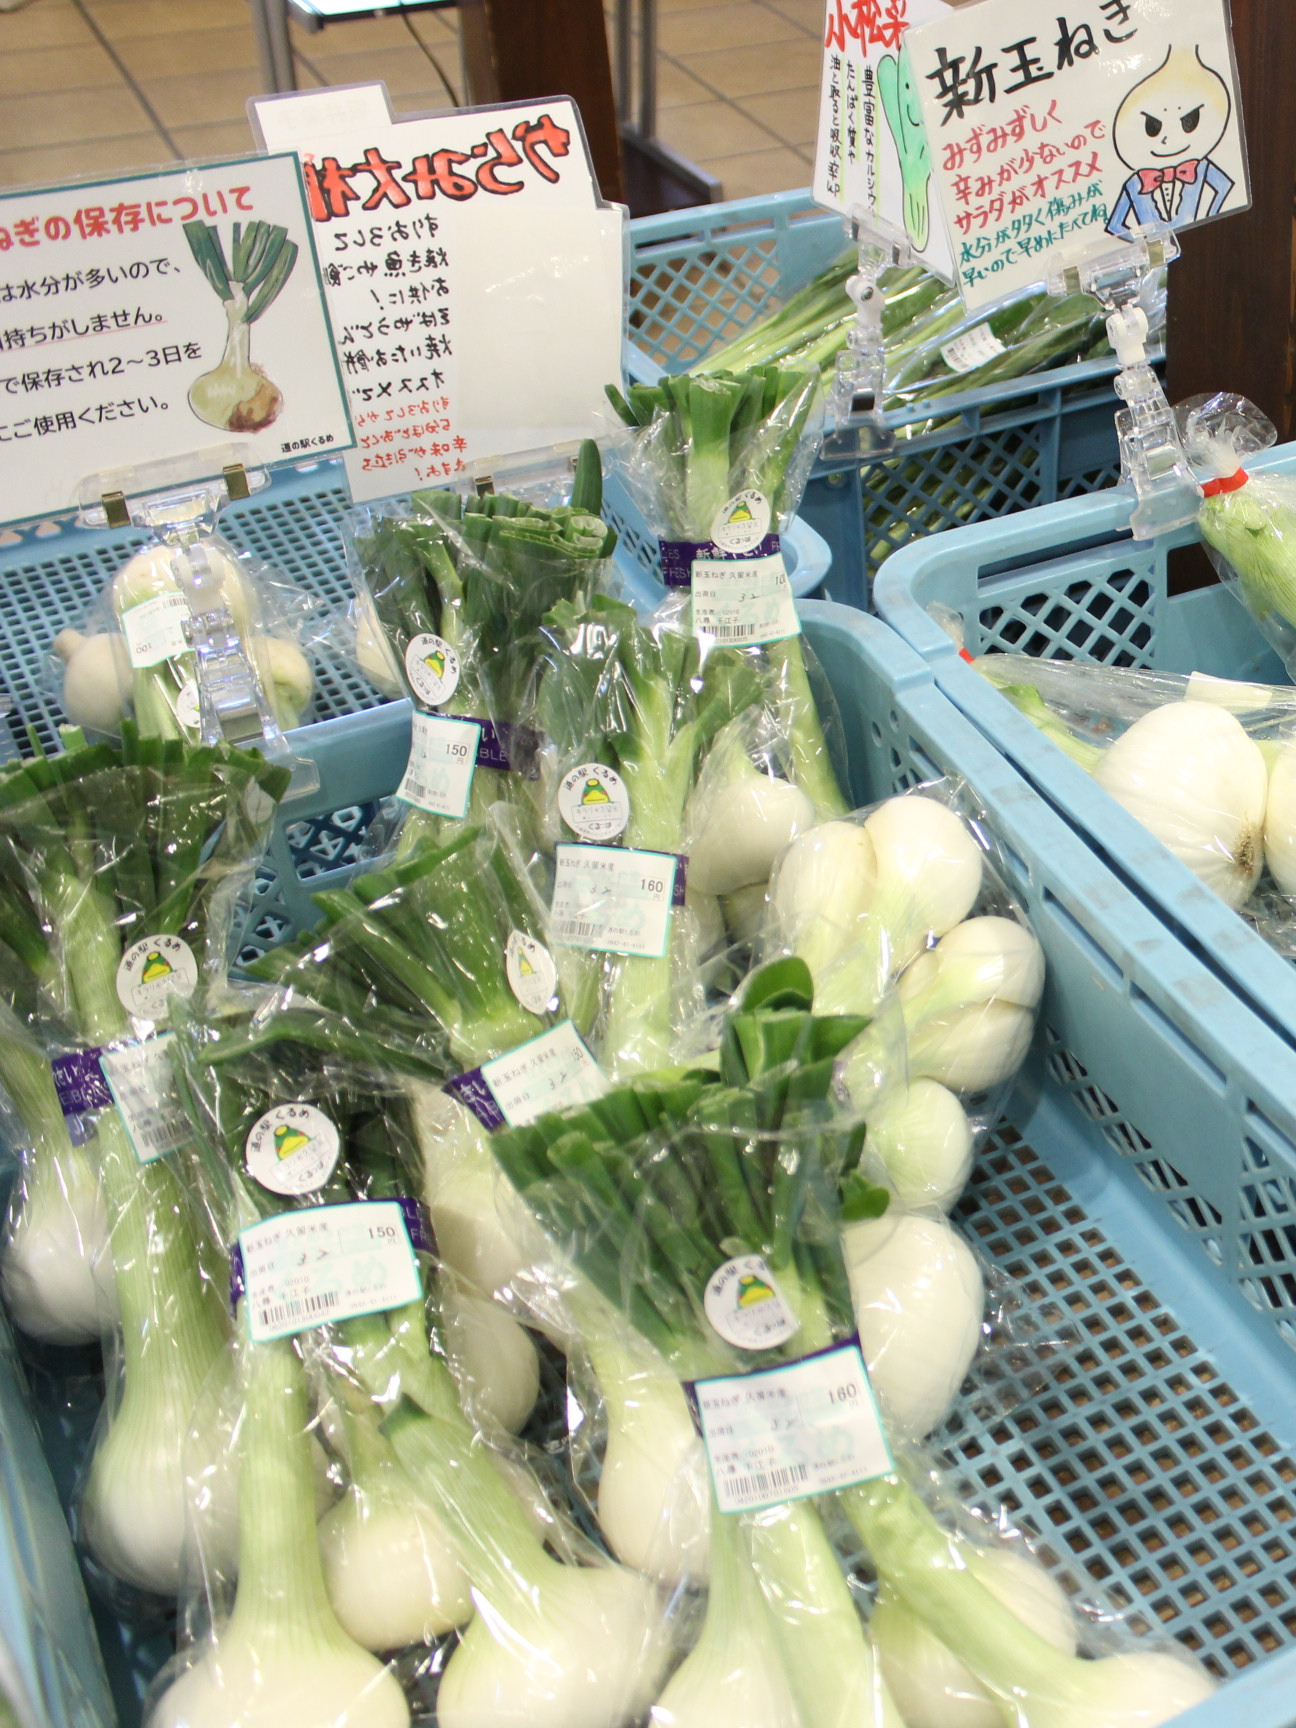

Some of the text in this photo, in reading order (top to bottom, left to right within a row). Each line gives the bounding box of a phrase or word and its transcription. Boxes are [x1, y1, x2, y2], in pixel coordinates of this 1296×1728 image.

[846, 60, 858, 165] たんぱく質や
[861, 64, 878, 219] 豊富なカルシウ
[942, 98, 1063, 171] みずみずしく
[950, 119, 1107, 206] 辛みが少ないので
[953, 151, 1104, 236] サラダがオススメ
[0, 306, 165, 349] 持ちがしません。
[280, 432, 334, 454] 道の駅くるめ
[695, 568, 758, 581] 新玉ねぎ 久留米産
[695, 589, 715, 599] 出荷日
[445, 741, 468, 758] 150
[563, 765, 618, 792] 道の駅 くるめ
[583, 859, 614, 871] 久留米産
[639, 878, 664, 892] 160
[153, 936, 182, 952] くるめ
[250, 1107, 310, 1153] 道の駅 くるめ
[285, 1222, 326, 1236] 久留米産
[367, 1223, 395, 1239] 150
[744, 1259, 767, 1272] くる
[827, 1384, 857, 1402] 160
